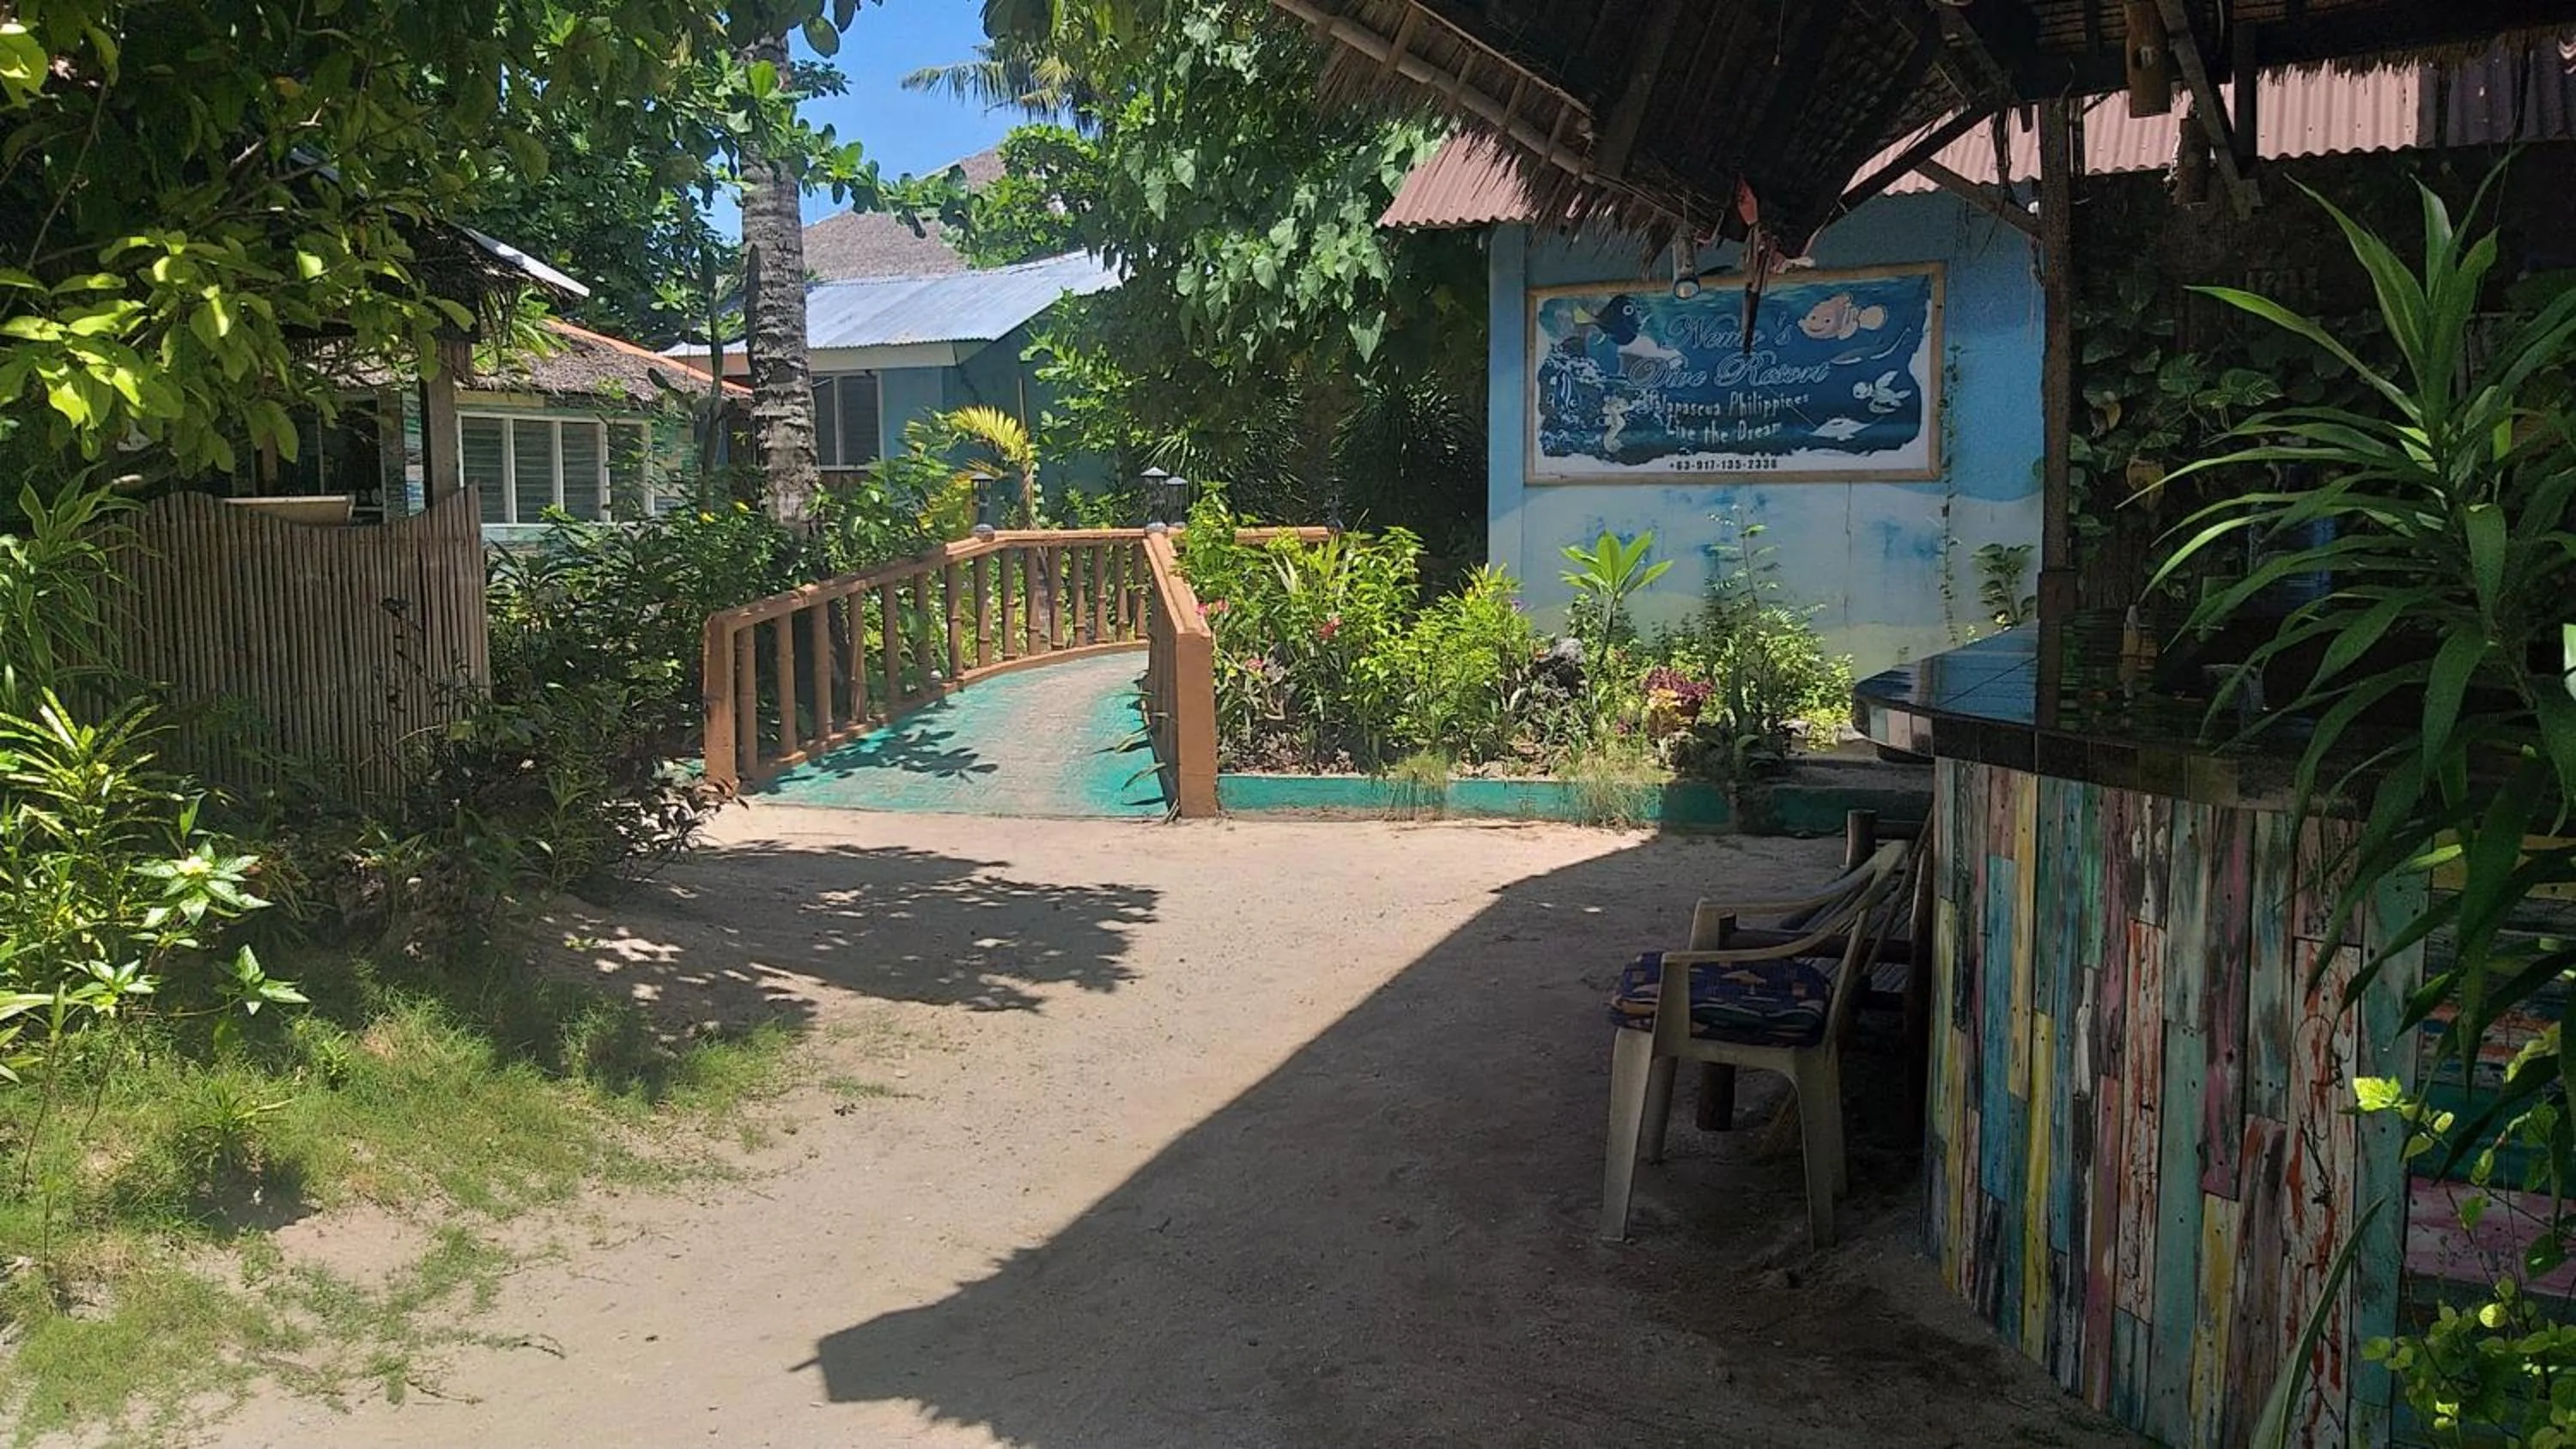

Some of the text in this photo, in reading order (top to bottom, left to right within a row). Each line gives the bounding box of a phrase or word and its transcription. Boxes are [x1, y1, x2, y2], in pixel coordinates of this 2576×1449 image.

[1628, 350, 1830, 388] Dive Resort
[1728, 391, 1809, 417] Philippines
[1667, 412, 1782, 444] Live the Dream
